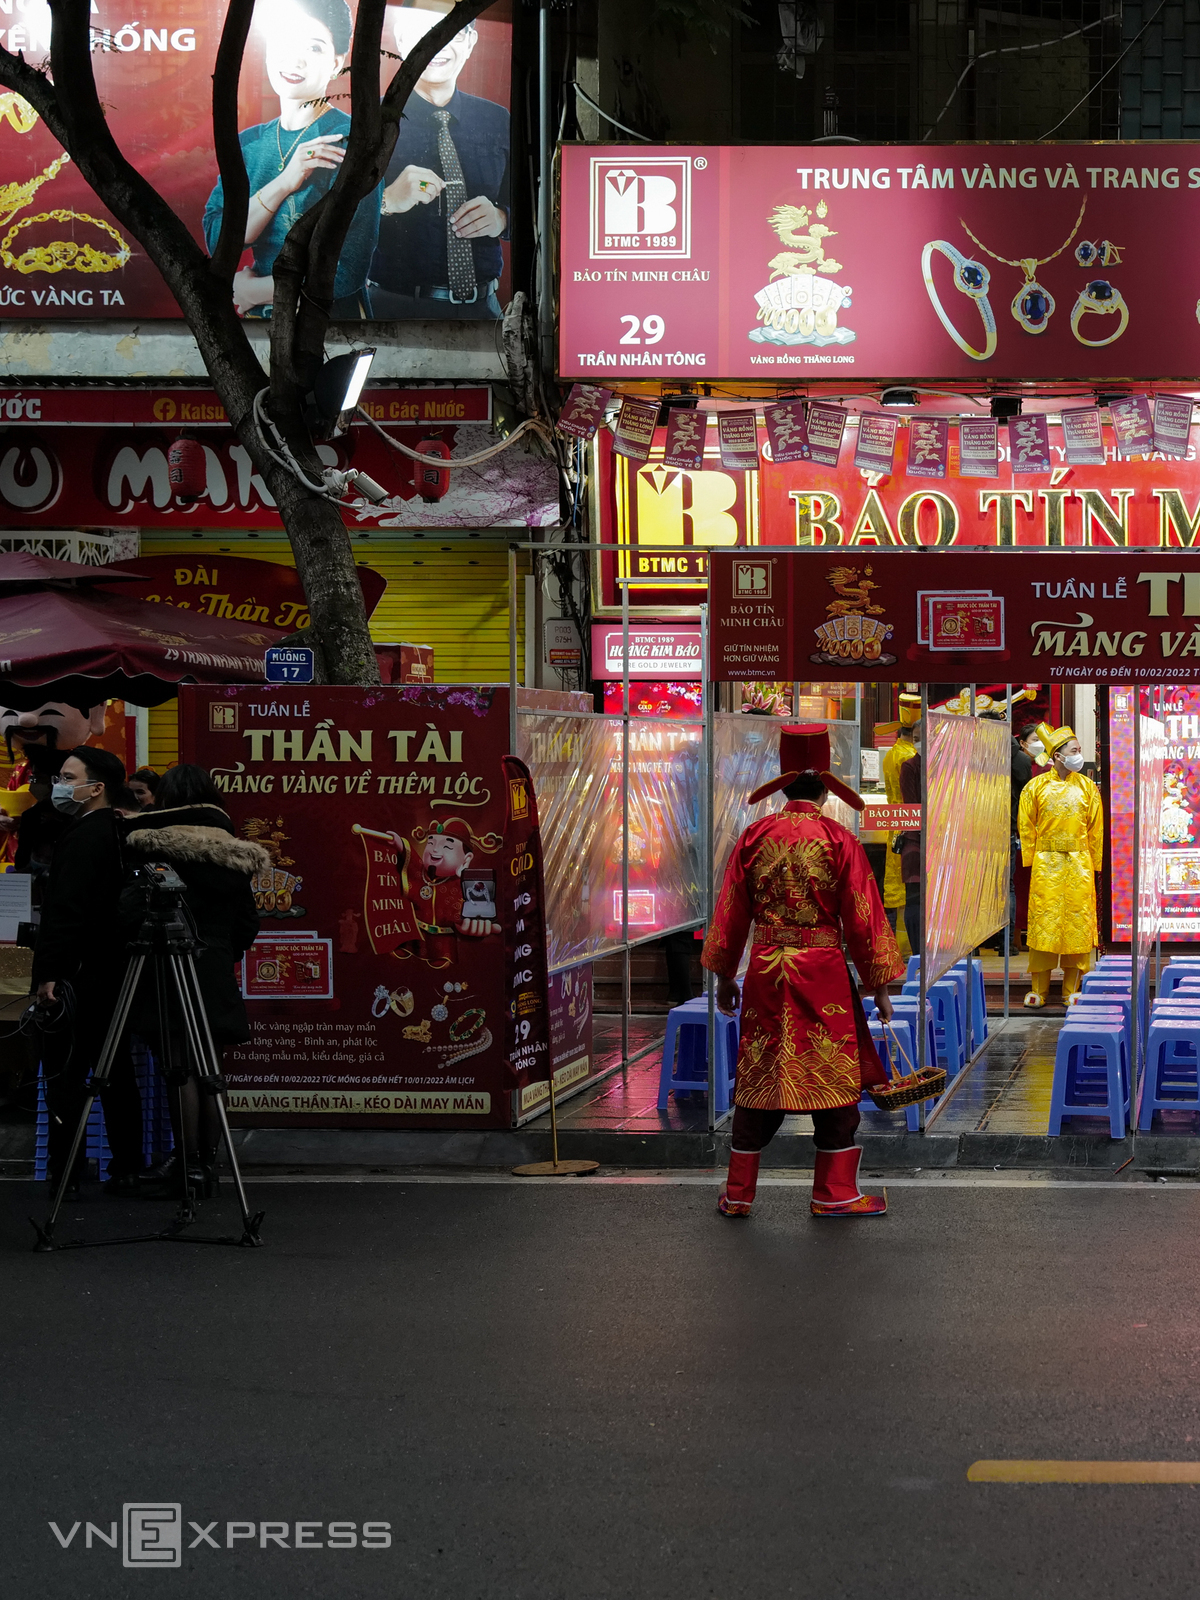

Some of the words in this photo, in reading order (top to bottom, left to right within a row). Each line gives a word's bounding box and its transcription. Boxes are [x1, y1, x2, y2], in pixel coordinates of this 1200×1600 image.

[796, 167, 891, 190] TRUNG
[897, 164, 953, 188] TÂM
[962, 164, 1036, 188] VÀNG
[1045, 164, 1079, 187] VÀ
[1086, 167, 1180, 189] TRANG
[604, 235, 641, 248] BTMC
[644, 235, 677, 248] 1989
[573, 268, 602, 282] BẢO
[603, 268, 628, 282] TÍN
[631, 270, 669, 282] MINH
[671, 267, 711, 282] CHÂU
[30, 285, 94, 306] VÀNG
[99, 289, 126, 306] TA
[620, 315, 665, 344] 29
[577, 350, 617, 366] TRẦN
[620, 350, 663, 366] NHÂN
[664, 350, 706, 366] TÔNG
[788, 467, 959, 547] BẢO
[978, 467, 1135, 547] TÍN
[638, 556, 690, 573] BTMC
[174, 564, 218, 586] ĐÀI
[1030, 577, 1095, 599] TUẦN
[1102, 576, 1128, 599] LỄ
[730, 603, 753, 614] BẢO
[756, 603, 775, 614] TÍN
[720, 618, 750, 627] MINH
[753, 616, 784, 627] CHÂU
[650, 645, 673, 657] KIM
[675, 642, 700, 657] BẢO
[724, 644, 739, 653] GIỮ
[740, 644, 753, 652] TÍN
[754, 644, 779, 654] NHIỆM
[281, 667, 300, 678] 17
[1050, 666, 1063, 677] TỪ
[1065, 666, 1093, 677] NGÀY
[1095, 668, 1108, 677] 06
[1110, 665, 1131, 677] ĐẾN
[1134, 667, 1191, 677] 10/02/2022
[248, 702, 290, 717] TUẦN
[294, 700, 311, 717] LỄ
[243, 718, 373, 763] THẦN
[388, 722, 463, 763] TÀI
[282, 770, 337, 794] VÀNG
[344, 769, 372, 793] VỀ
[377, 772, 436, 795] THÊM
[443, 772, 484, 799] LỘC
[869, 808, 890, 818] BẢO
[895, 808, 909, 818] TÍN
[254, 1021, 267, 1032] lộc
[268, 1021, 291, 1034] vàng
[292, 1021, 314, 1034] ngập
[316, 1021, 334, 1031] tràn
[335, 1024, 355, 1034] may
[356, 1020, 376, 1032] mắn
